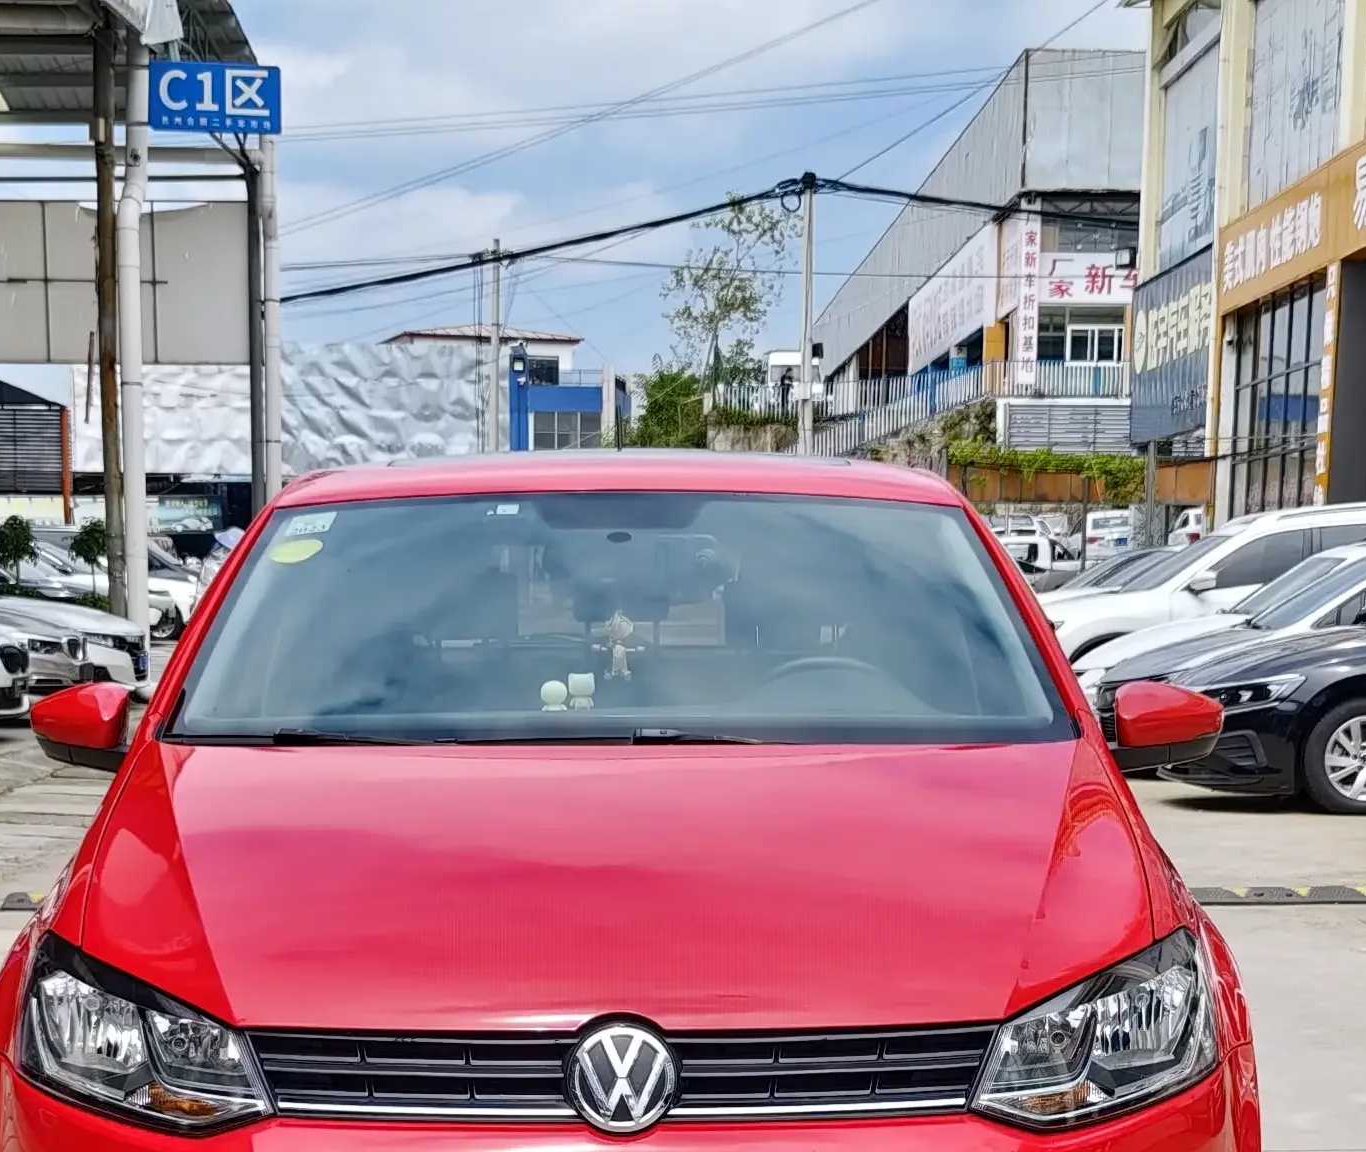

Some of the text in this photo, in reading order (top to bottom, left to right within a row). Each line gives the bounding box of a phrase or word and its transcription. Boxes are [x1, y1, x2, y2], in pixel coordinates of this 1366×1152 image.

[159, 69, 271, 117] C1区
[1020, 211, 1038, 373] 厂家新车折扣基地
[1048, 258, 1074, 299] 厂家
